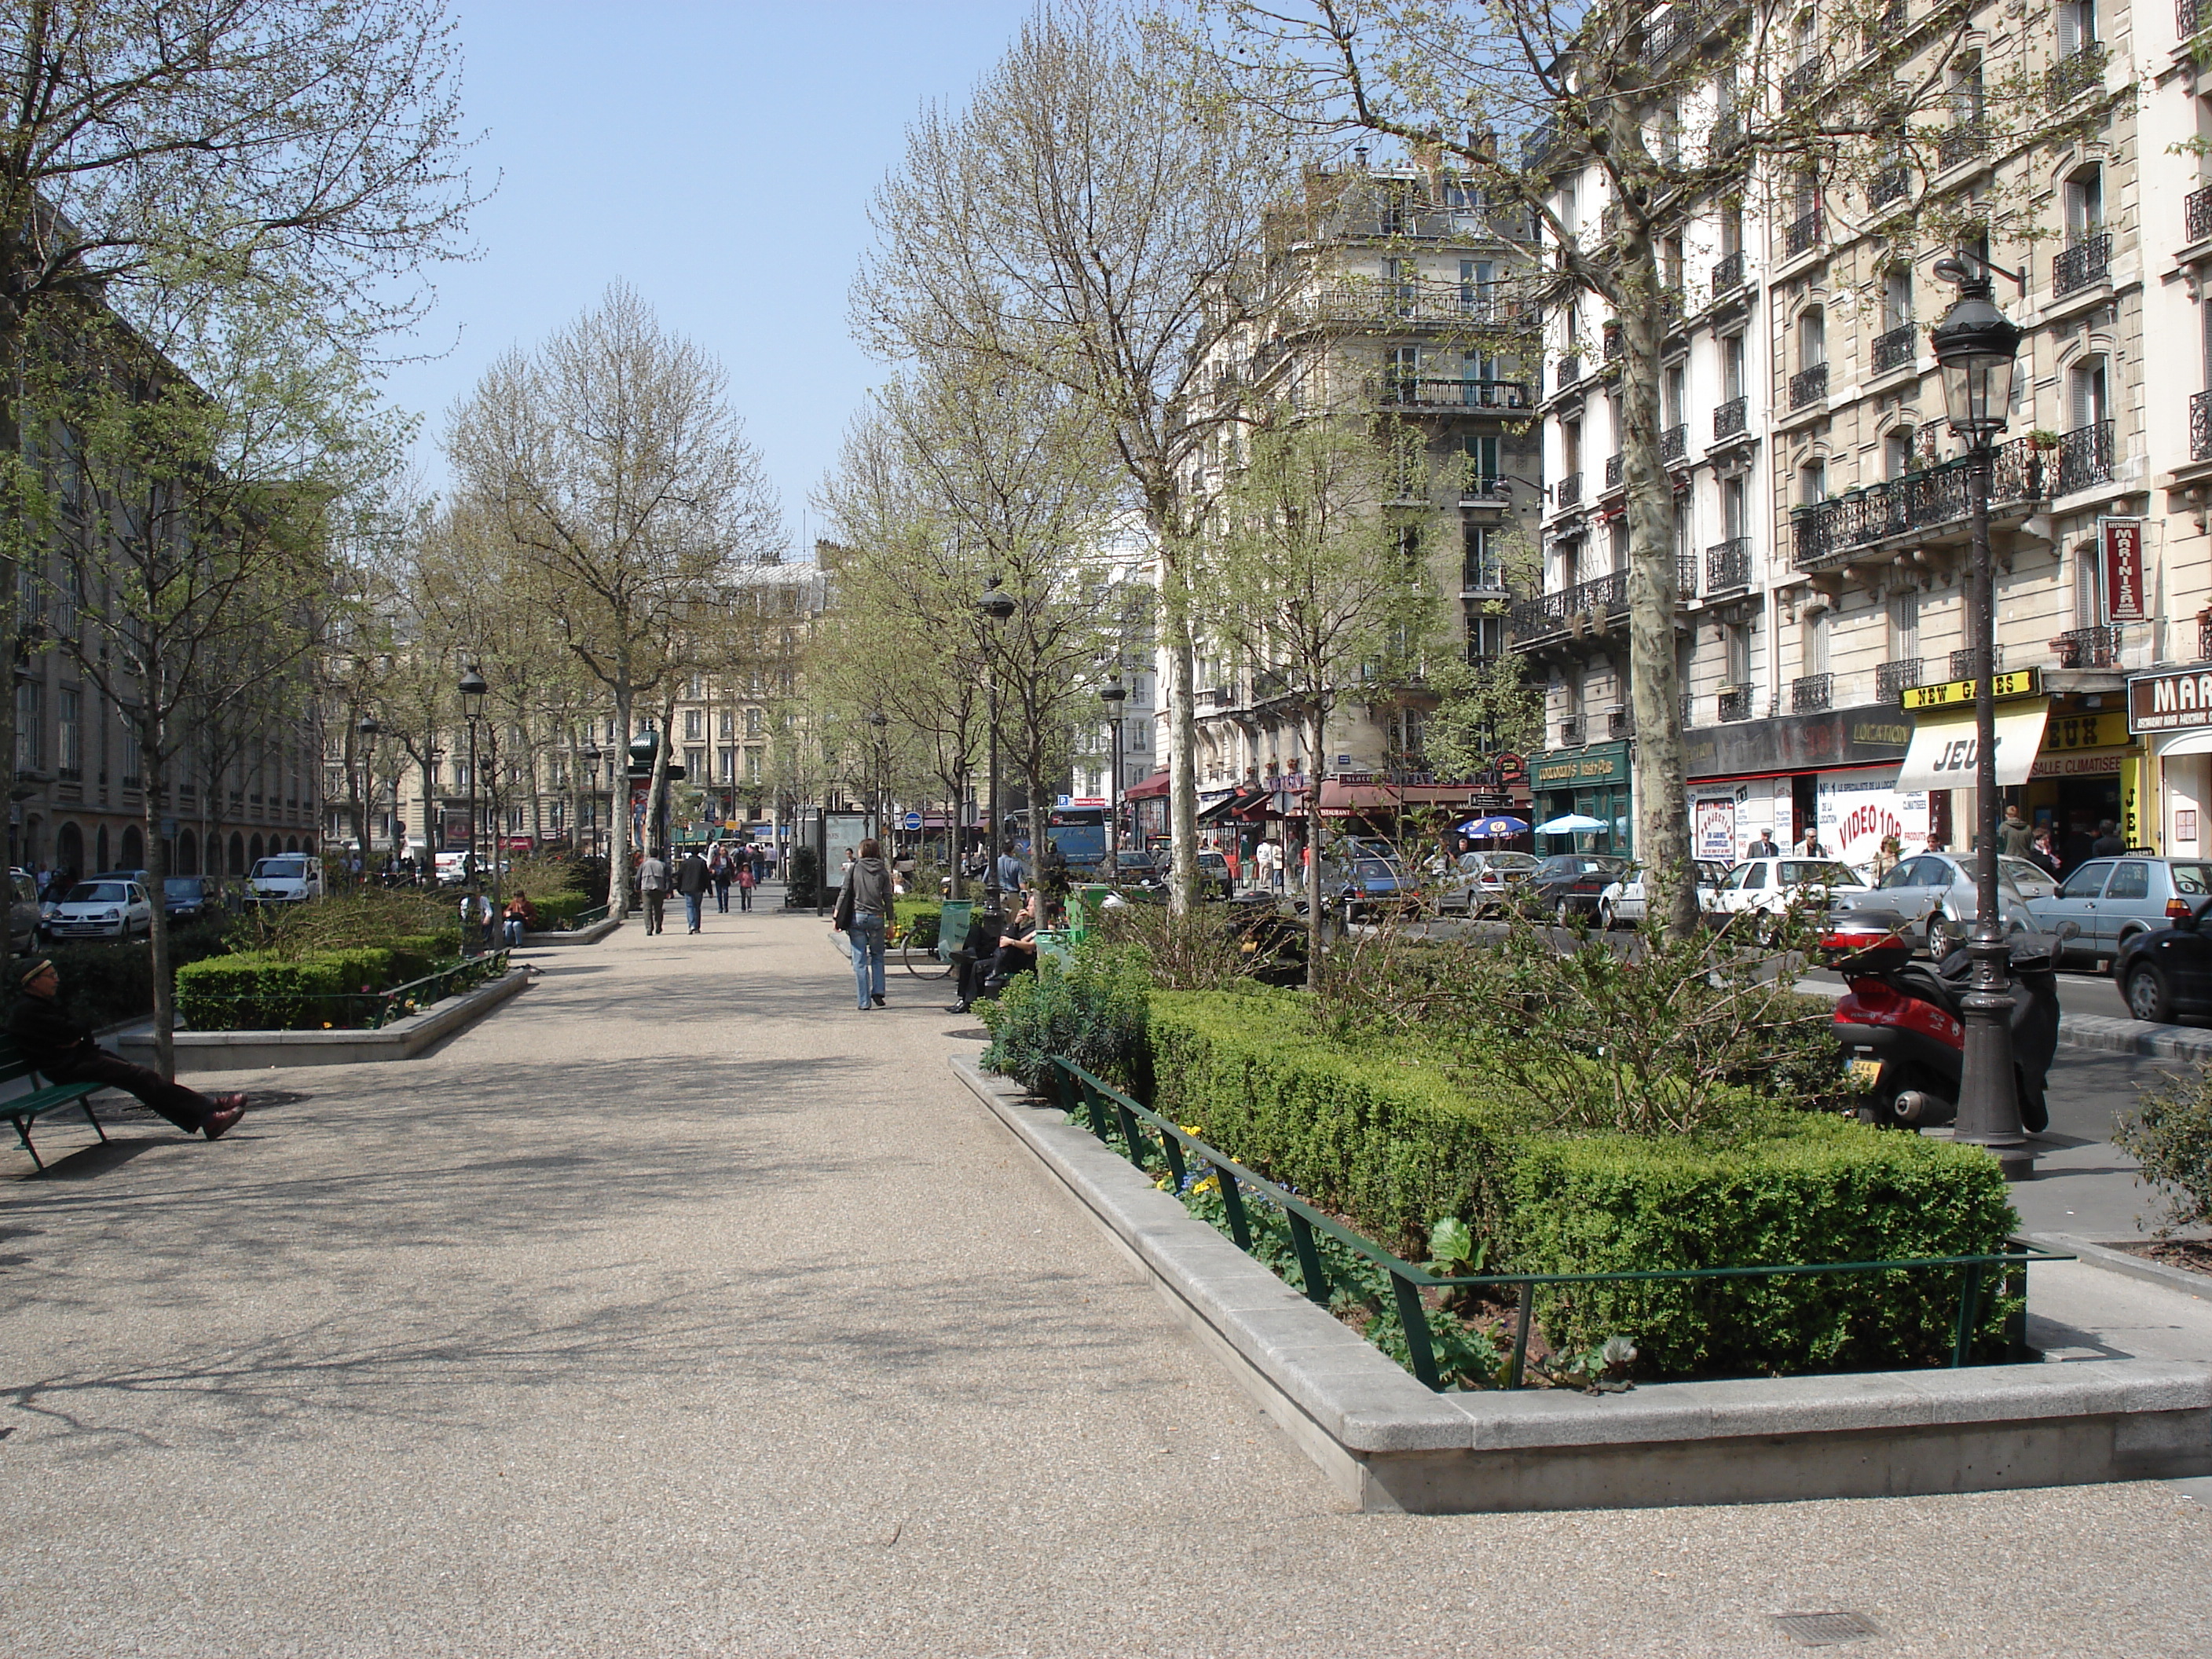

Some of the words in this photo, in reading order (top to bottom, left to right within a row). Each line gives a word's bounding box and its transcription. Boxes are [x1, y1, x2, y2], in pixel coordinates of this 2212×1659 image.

[2115, 529, 2133, 603] MARINISA
[1918, 686, 1947, 705] NEW
[1962, 676, 2013, 698] GES
[2048, 717, 2098, 749] EUX
[1933, 737, 2001, 771] JEU
[2032, 760, 2061, 775] SALLE
[2065, 756, 2122, 774] CLIMATISEE
[1831, 782, 1836, 797] 1
[1701, 811, 1734, 842] PROJECTION
[1839, 804, 1877, 851] VIDEO
